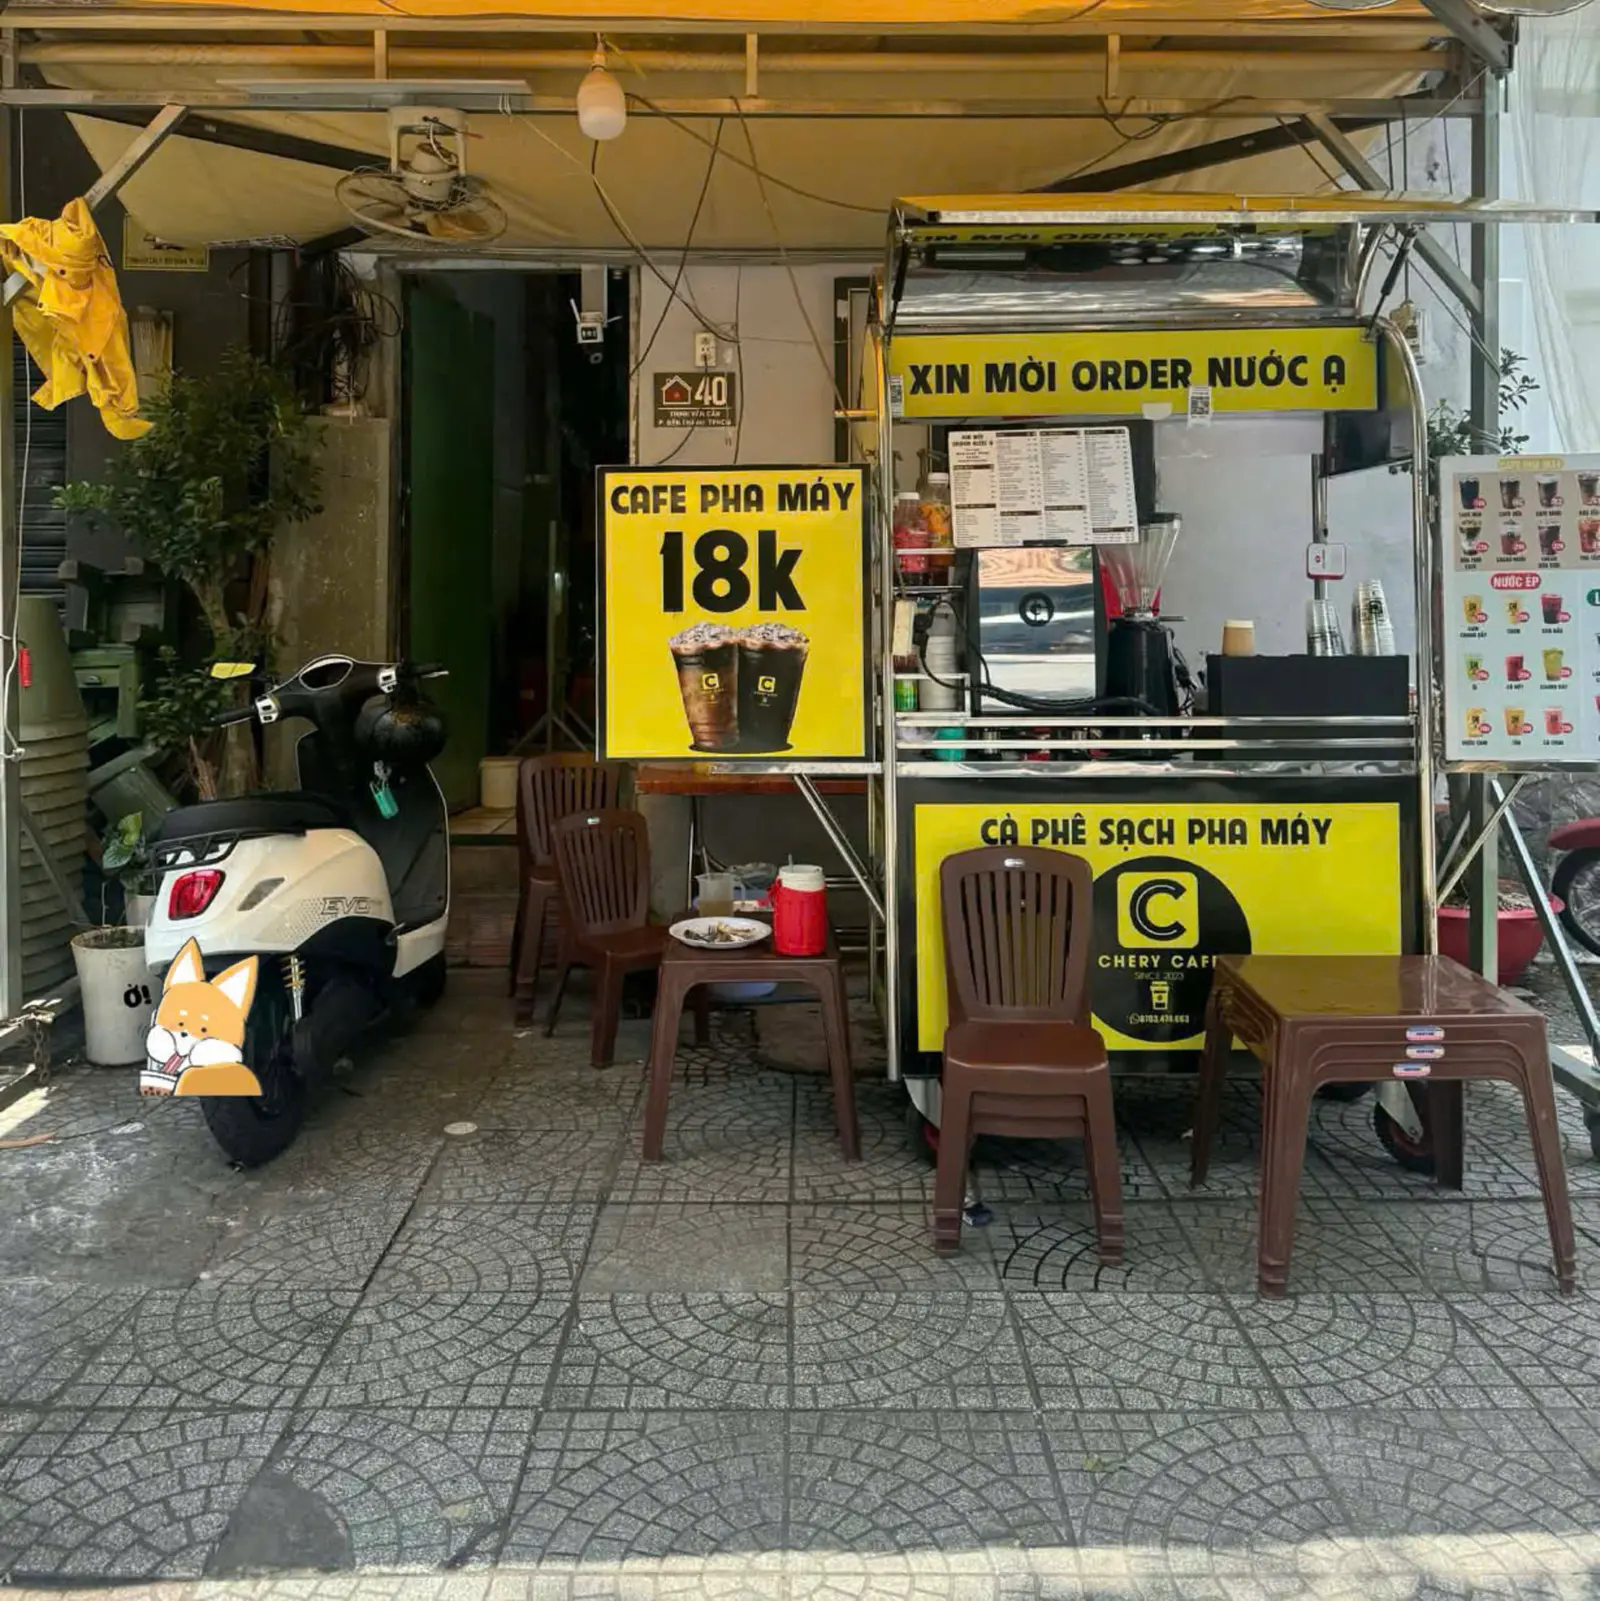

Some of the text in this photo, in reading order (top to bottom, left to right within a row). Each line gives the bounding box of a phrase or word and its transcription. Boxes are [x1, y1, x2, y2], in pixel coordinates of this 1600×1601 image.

[694, 376, 727, 406] 40
[909, 349, 1345, 395] XIN MỜI ORDER NƯỚC Ạ
[610, 477, 855, 515] CAFE PHA MÁY
[659, 529, 807, 613] 18k
[1493, 573, 1540, 588] NƯỚC ÉP
[981, 812, 1332, 851] CÀ PHÊ SẠCH PHA MÁY
[1130, 879, 1187, 941] C
[1098, 955, 1160, 968] CHERY
[1134, 971, 1185, 981] SINCE 2023
